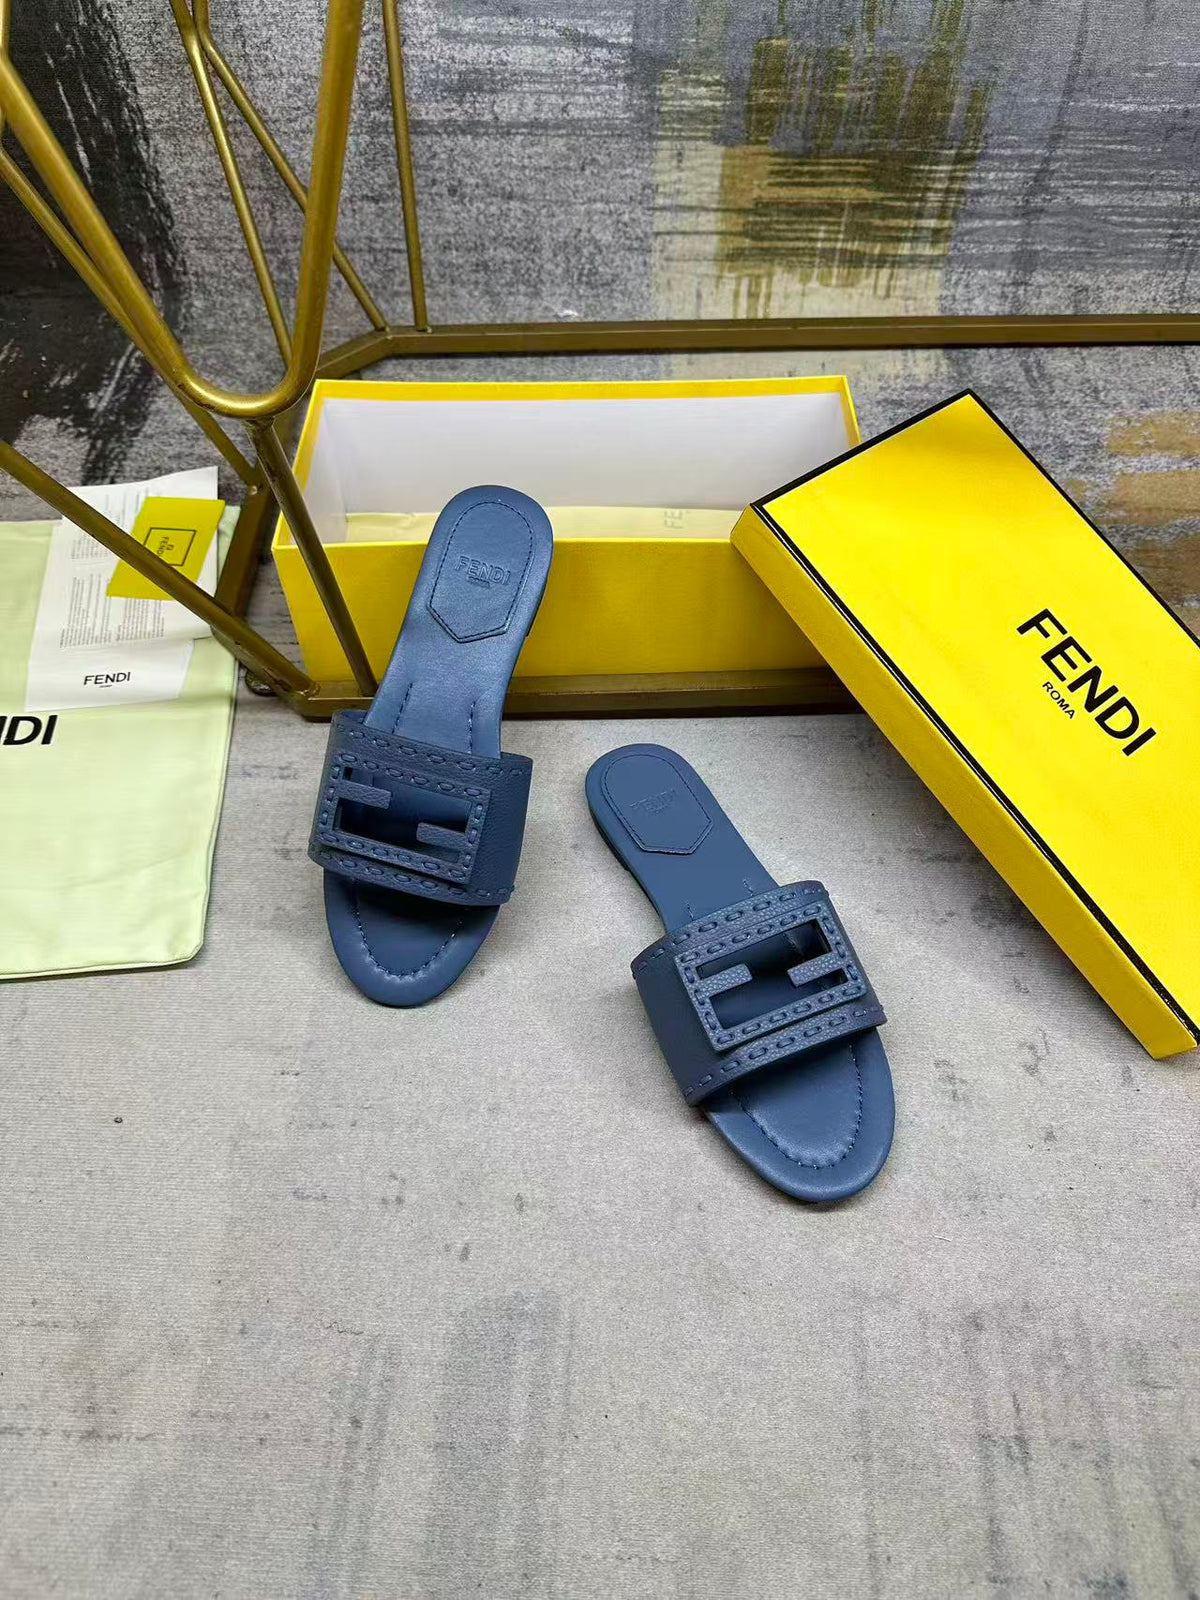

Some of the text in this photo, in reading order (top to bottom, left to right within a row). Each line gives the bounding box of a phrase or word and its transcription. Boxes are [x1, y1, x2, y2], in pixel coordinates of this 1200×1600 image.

[455, 555, 511, 585] FENDI
[83, 671, 131, 685] FENDI
[1016, 608, 1157, 757] FENDI
[1042, 681, 1076, 719] ROMA
